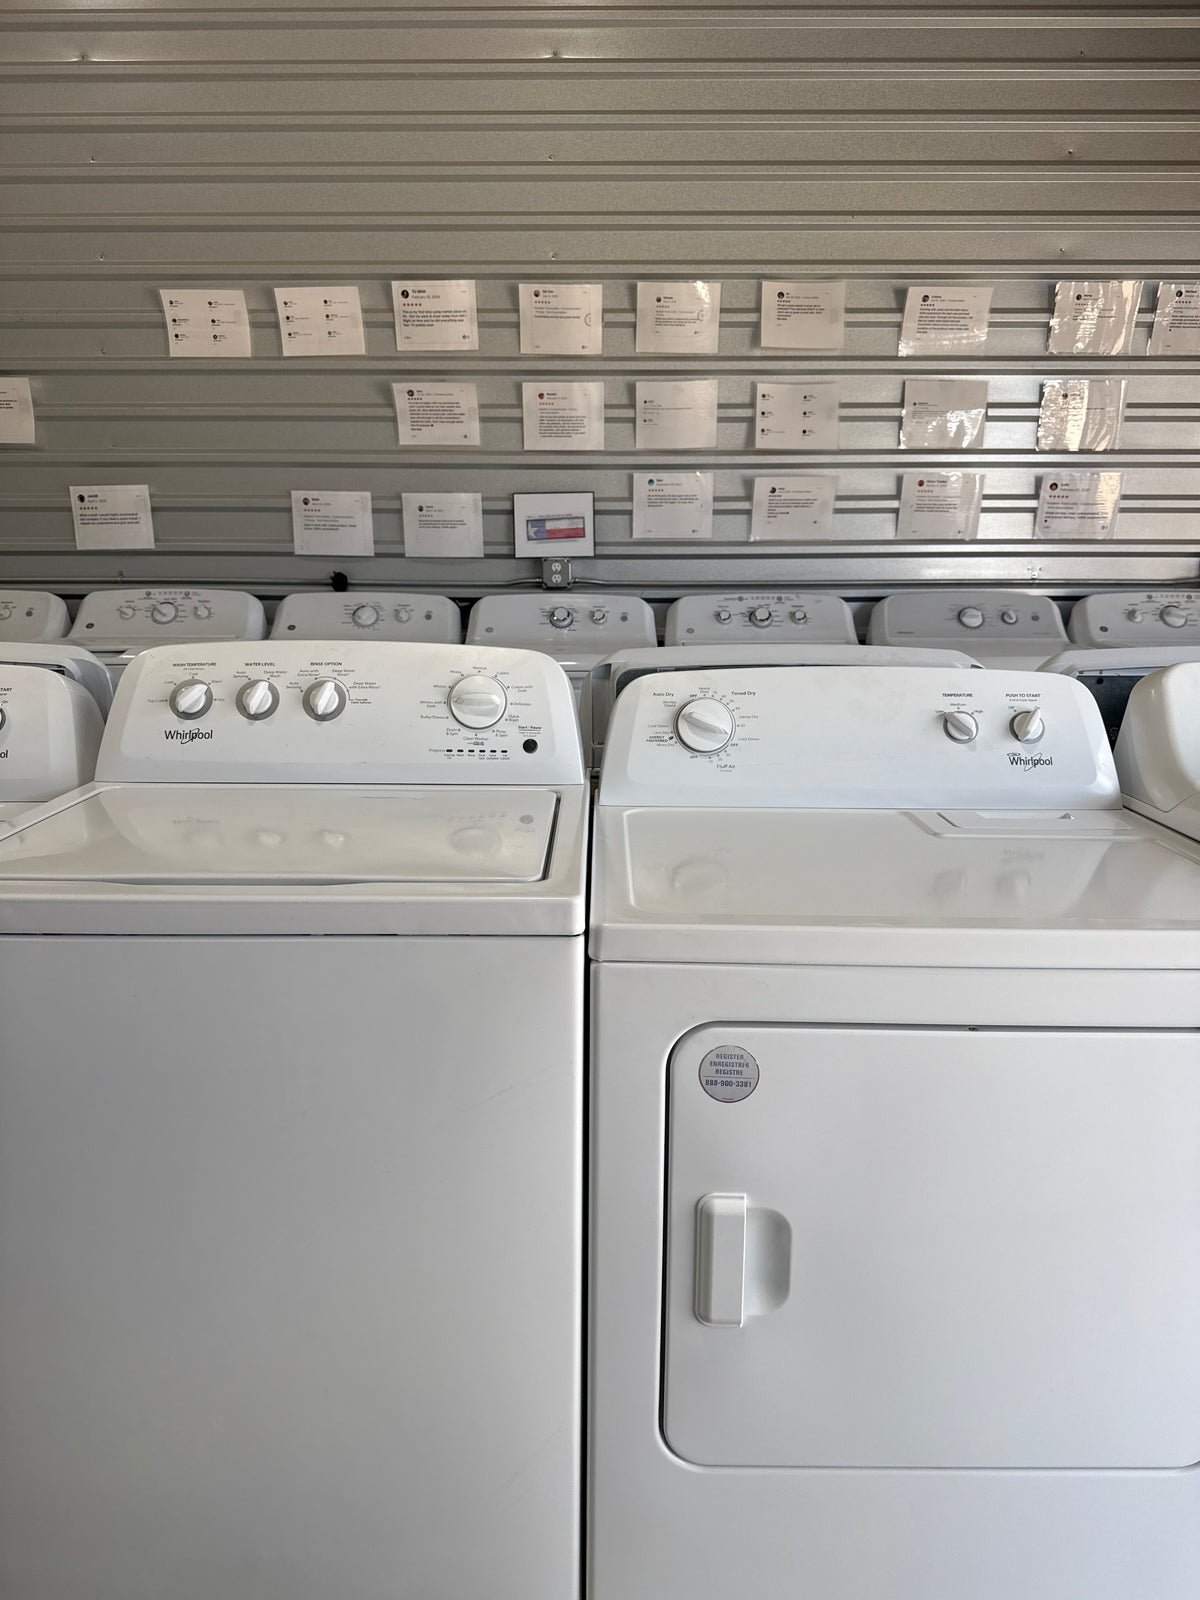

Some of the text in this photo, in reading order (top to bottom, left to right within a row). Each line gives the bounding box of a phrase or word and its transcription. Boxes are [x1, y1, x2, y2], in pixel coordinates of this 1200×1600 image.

[164, 729, 214, 743] Whirlpool
[1008, 755, 1053, 769] Whirlpool
[705, 1079, 751, 1088] 888-900-3381
